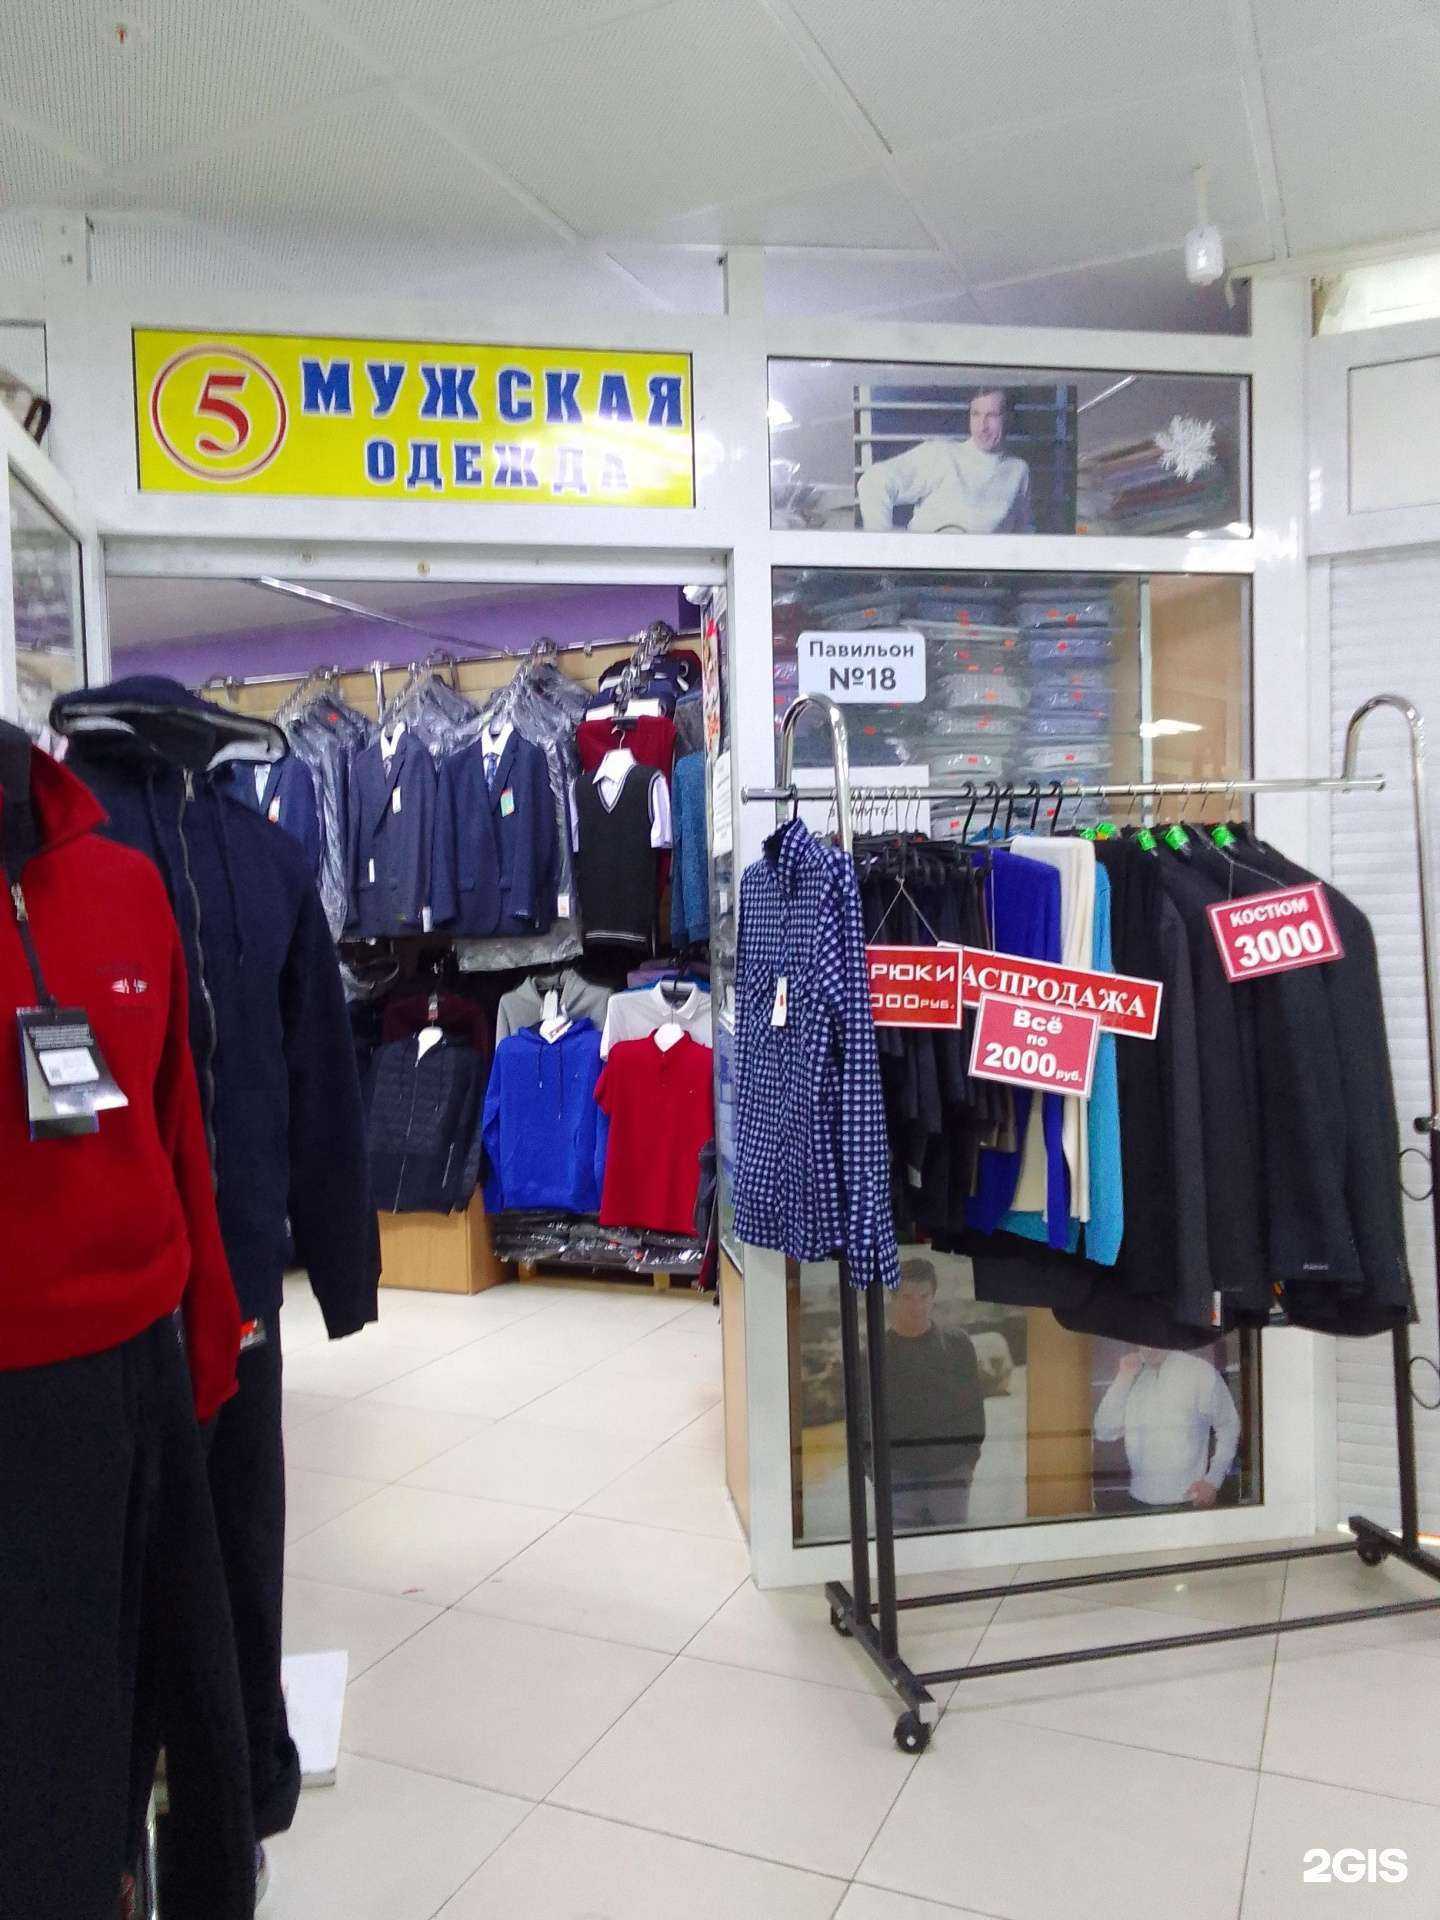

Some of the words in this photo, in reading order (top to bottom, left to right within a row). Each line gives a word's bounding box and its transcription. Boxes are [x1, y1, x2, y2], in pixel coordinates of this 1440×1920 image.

[196, 372, 250, 453] 5
[301, 359, 683, 428] МУЖСКАЯ
[366, 439, 629, 494] ОДЕЖДА
[809, 640, 914, 658] Павильон
[829, 667, 897, 691] №18
[1234, 919, 1324, 968] 3000
[870, 963, 956, 983] РЮКИ
[962, 963, 1147, 1019] АСПРОДАЖА
[1012, 1007, 1064, 1035] Всё
[1026, 1032, 1049, 1048] по
